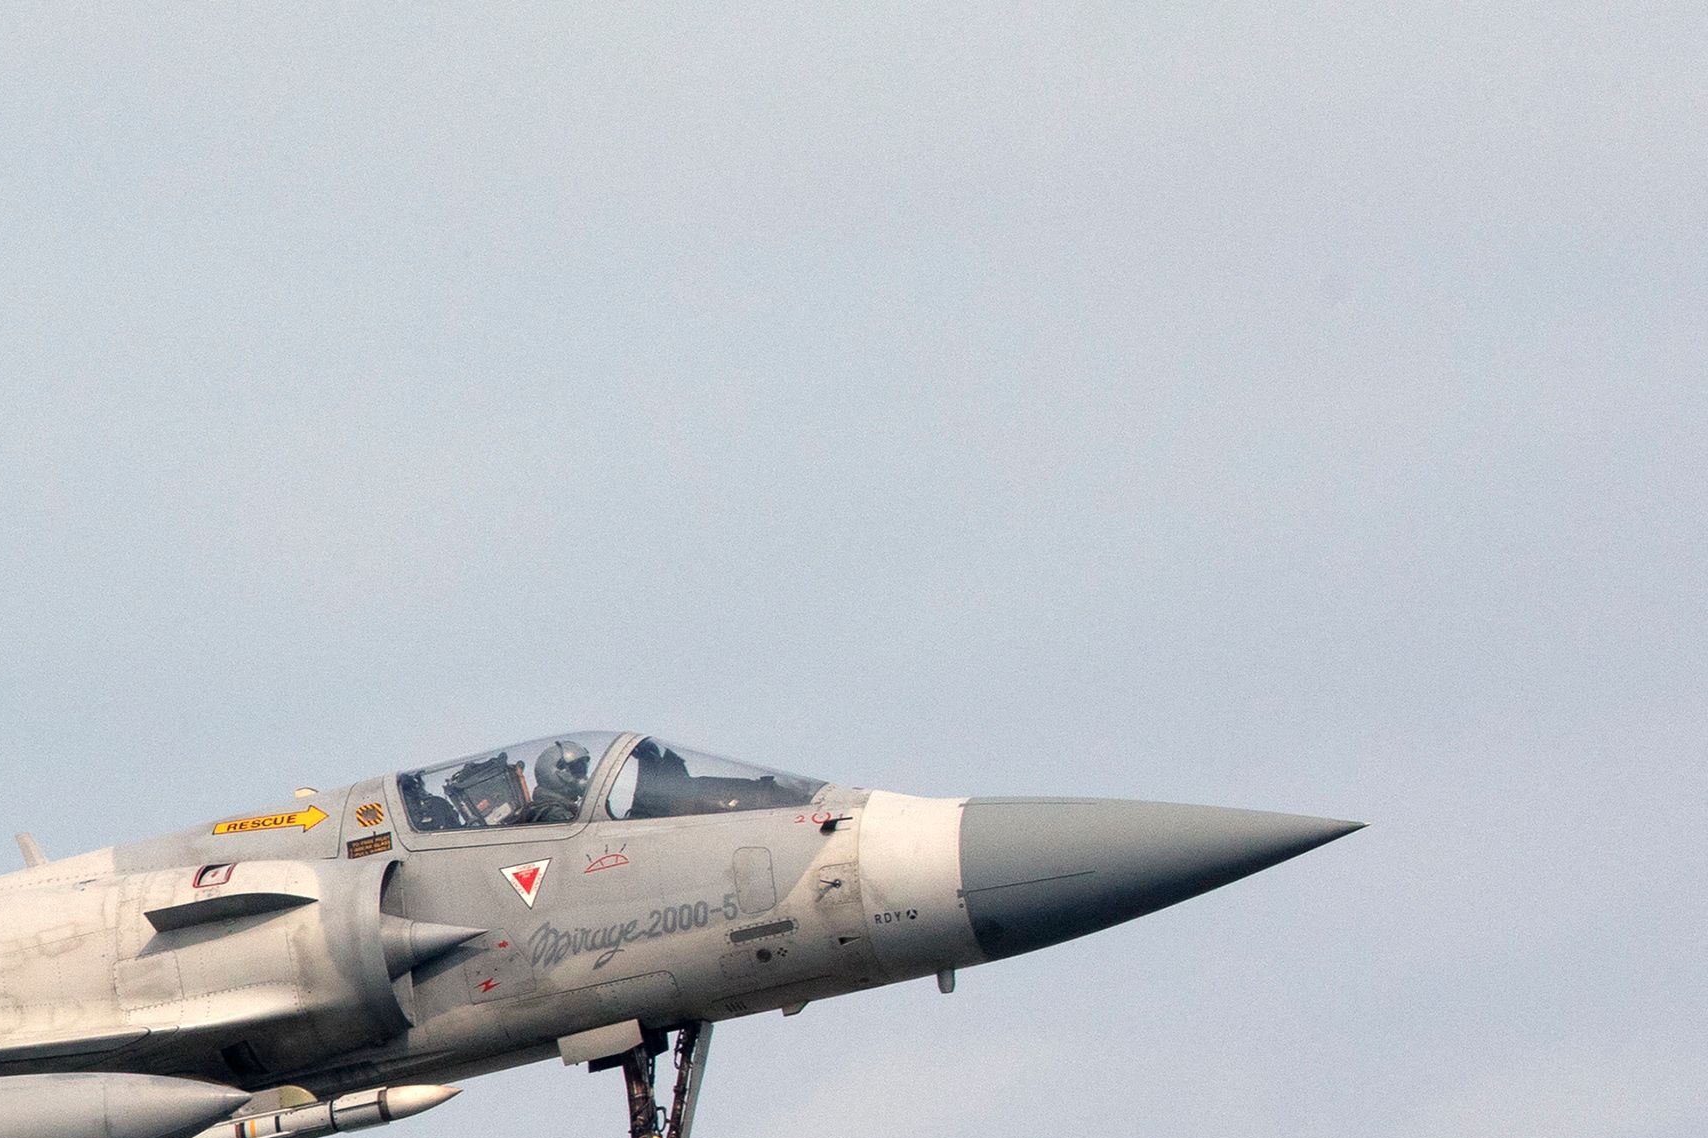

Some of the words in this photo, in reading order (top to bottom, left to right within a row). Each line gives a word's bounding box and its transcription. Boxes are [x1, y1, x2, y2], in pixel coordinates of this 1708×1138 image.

[227, 815, 297, 831] RESCUE
[794, 814, 805, 824] 2
[874, 911, 901, 924] RDY
[528, 919, 647, 970] Mirage
[645, 892, 738, 938] 2000-5
